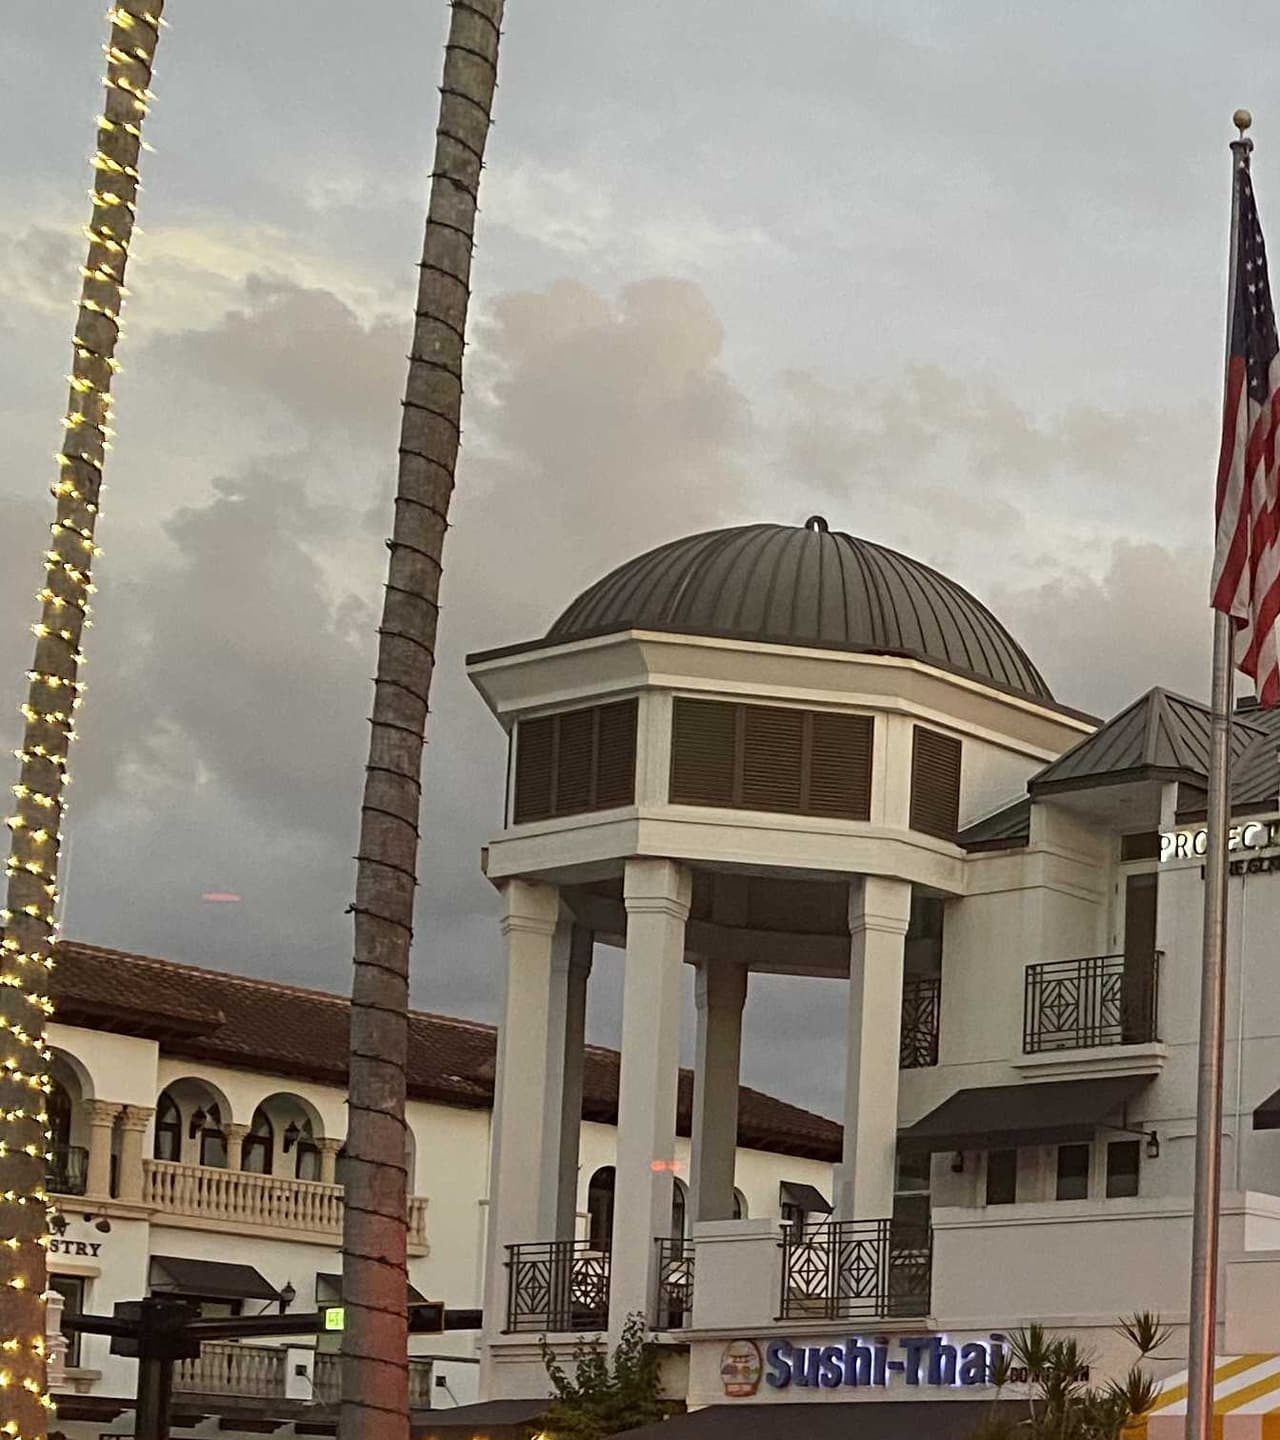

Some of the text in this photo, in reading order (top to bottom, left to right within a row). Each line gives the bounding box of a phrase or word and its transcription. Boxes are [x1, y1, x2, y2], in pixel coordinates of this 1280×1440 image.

[1159, 820, 1280, 860] PROECT
[49, 1239, 102, 1257] STRY
[766, 1333, 1006, 1389] Sushi-Thai
